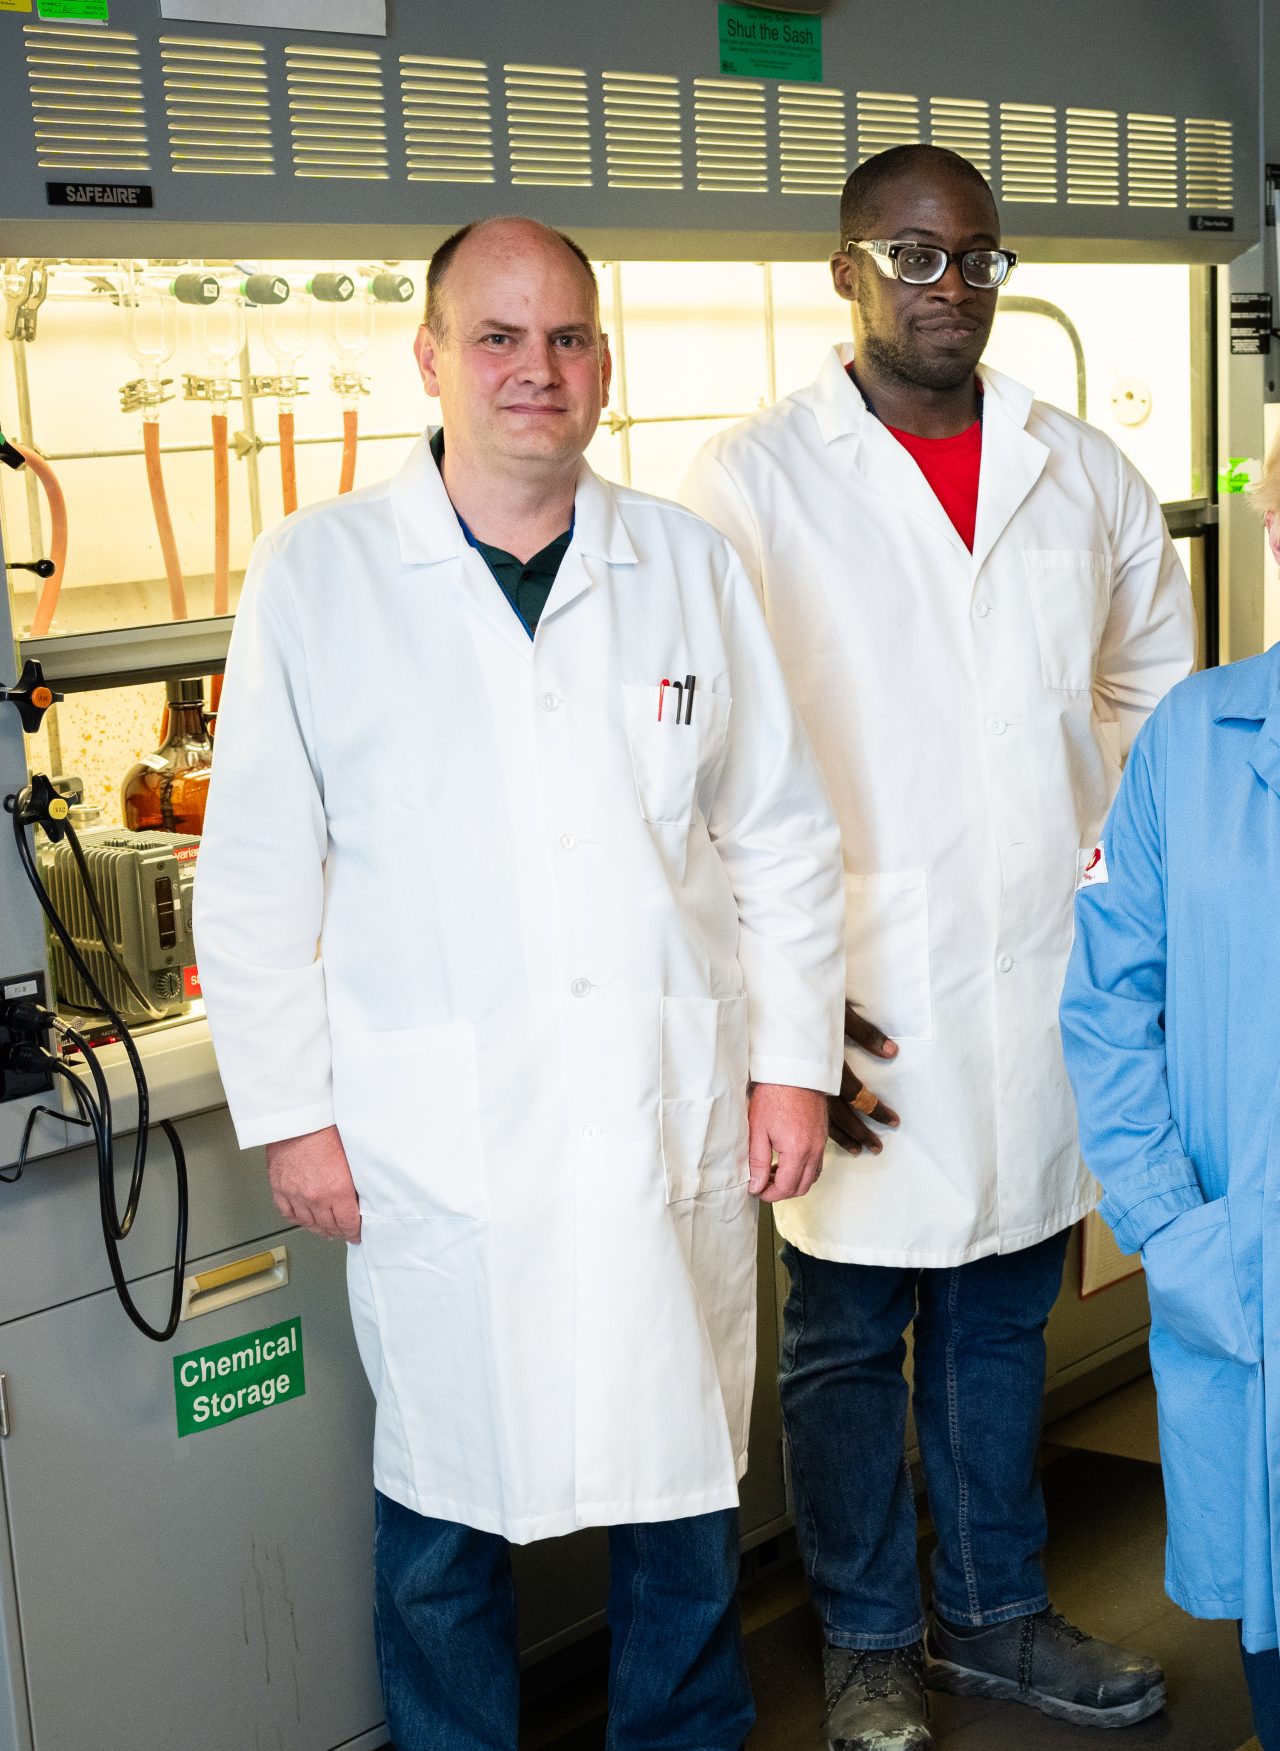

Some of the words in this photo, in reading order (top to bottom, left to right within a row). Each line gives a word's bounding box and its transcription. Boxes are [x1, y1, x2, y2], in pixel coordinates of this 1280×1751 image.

[727, 18, 756, 39] Shut
[760, 22, 779, 41] the
[782, 25, 813, 44] Sash
[180, 1326, 297, 1388] Chemical
[193, 1373, 290, 1423] Storage
